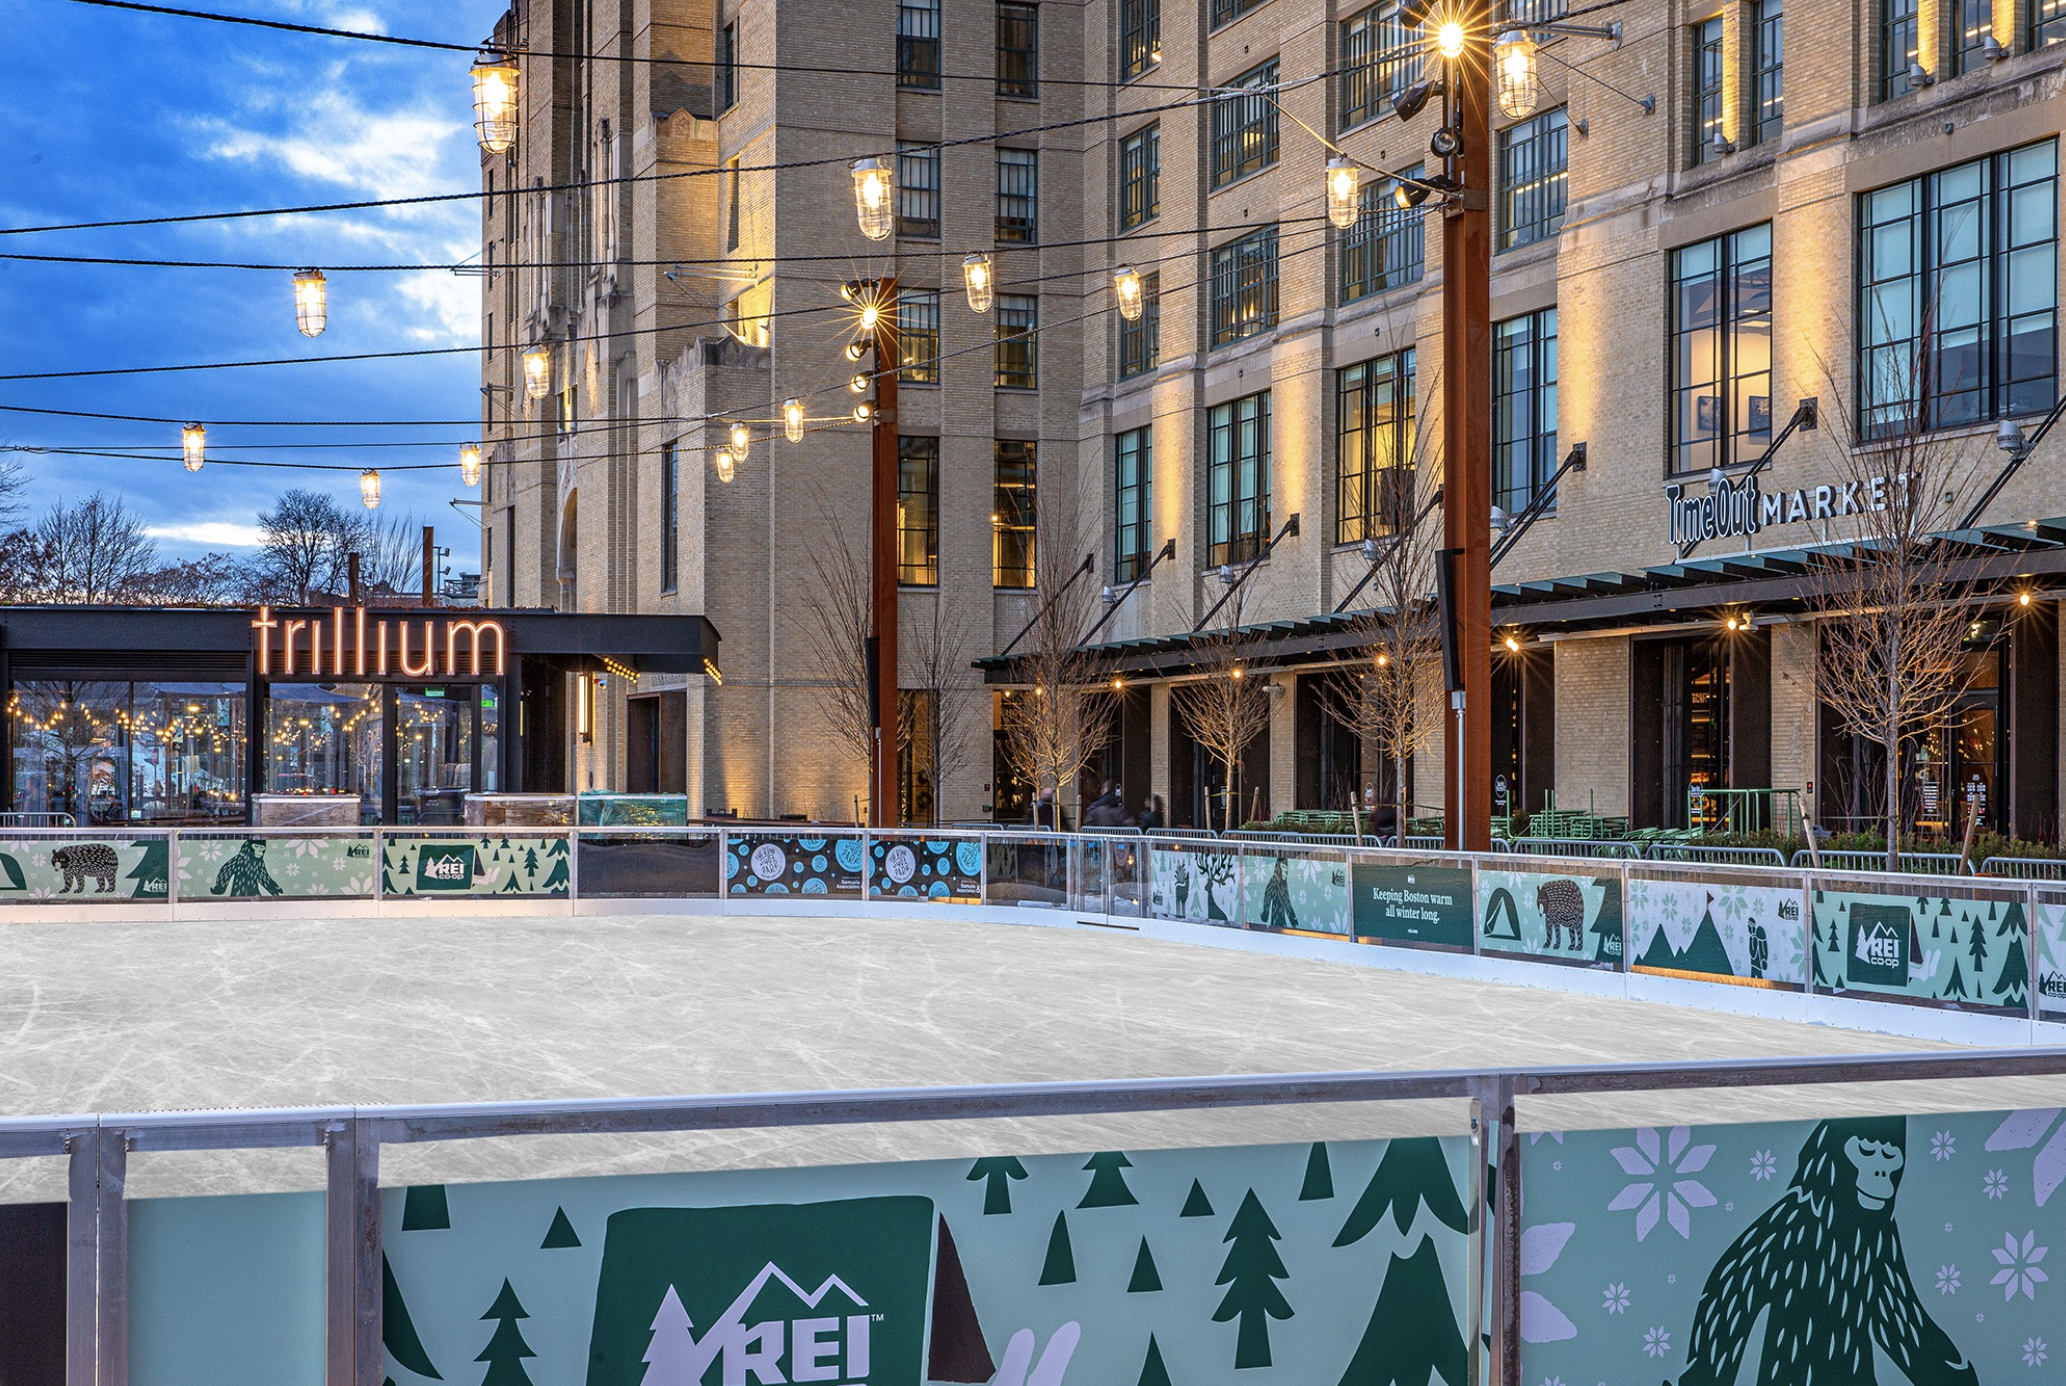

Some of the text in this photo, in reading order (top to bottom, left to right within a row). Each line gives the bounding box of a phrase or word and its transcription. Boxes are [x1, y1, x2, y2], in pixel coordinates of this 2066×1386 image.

[1762, 473, 1914, 526] MARKET
[251, 606, 504, 677] trillium
[841, 848, 862, 865] PARK
[438, 863, 464, 874] REI
[1373, 887, 1453, 906] Keeping Boston warm
[1385, 905, 1440, 924] all winter long.
[1785, 906, 1799, 917] REI
[1870, 938, 1899, 958] REI
[722, 1314, 870, 1386] REI
